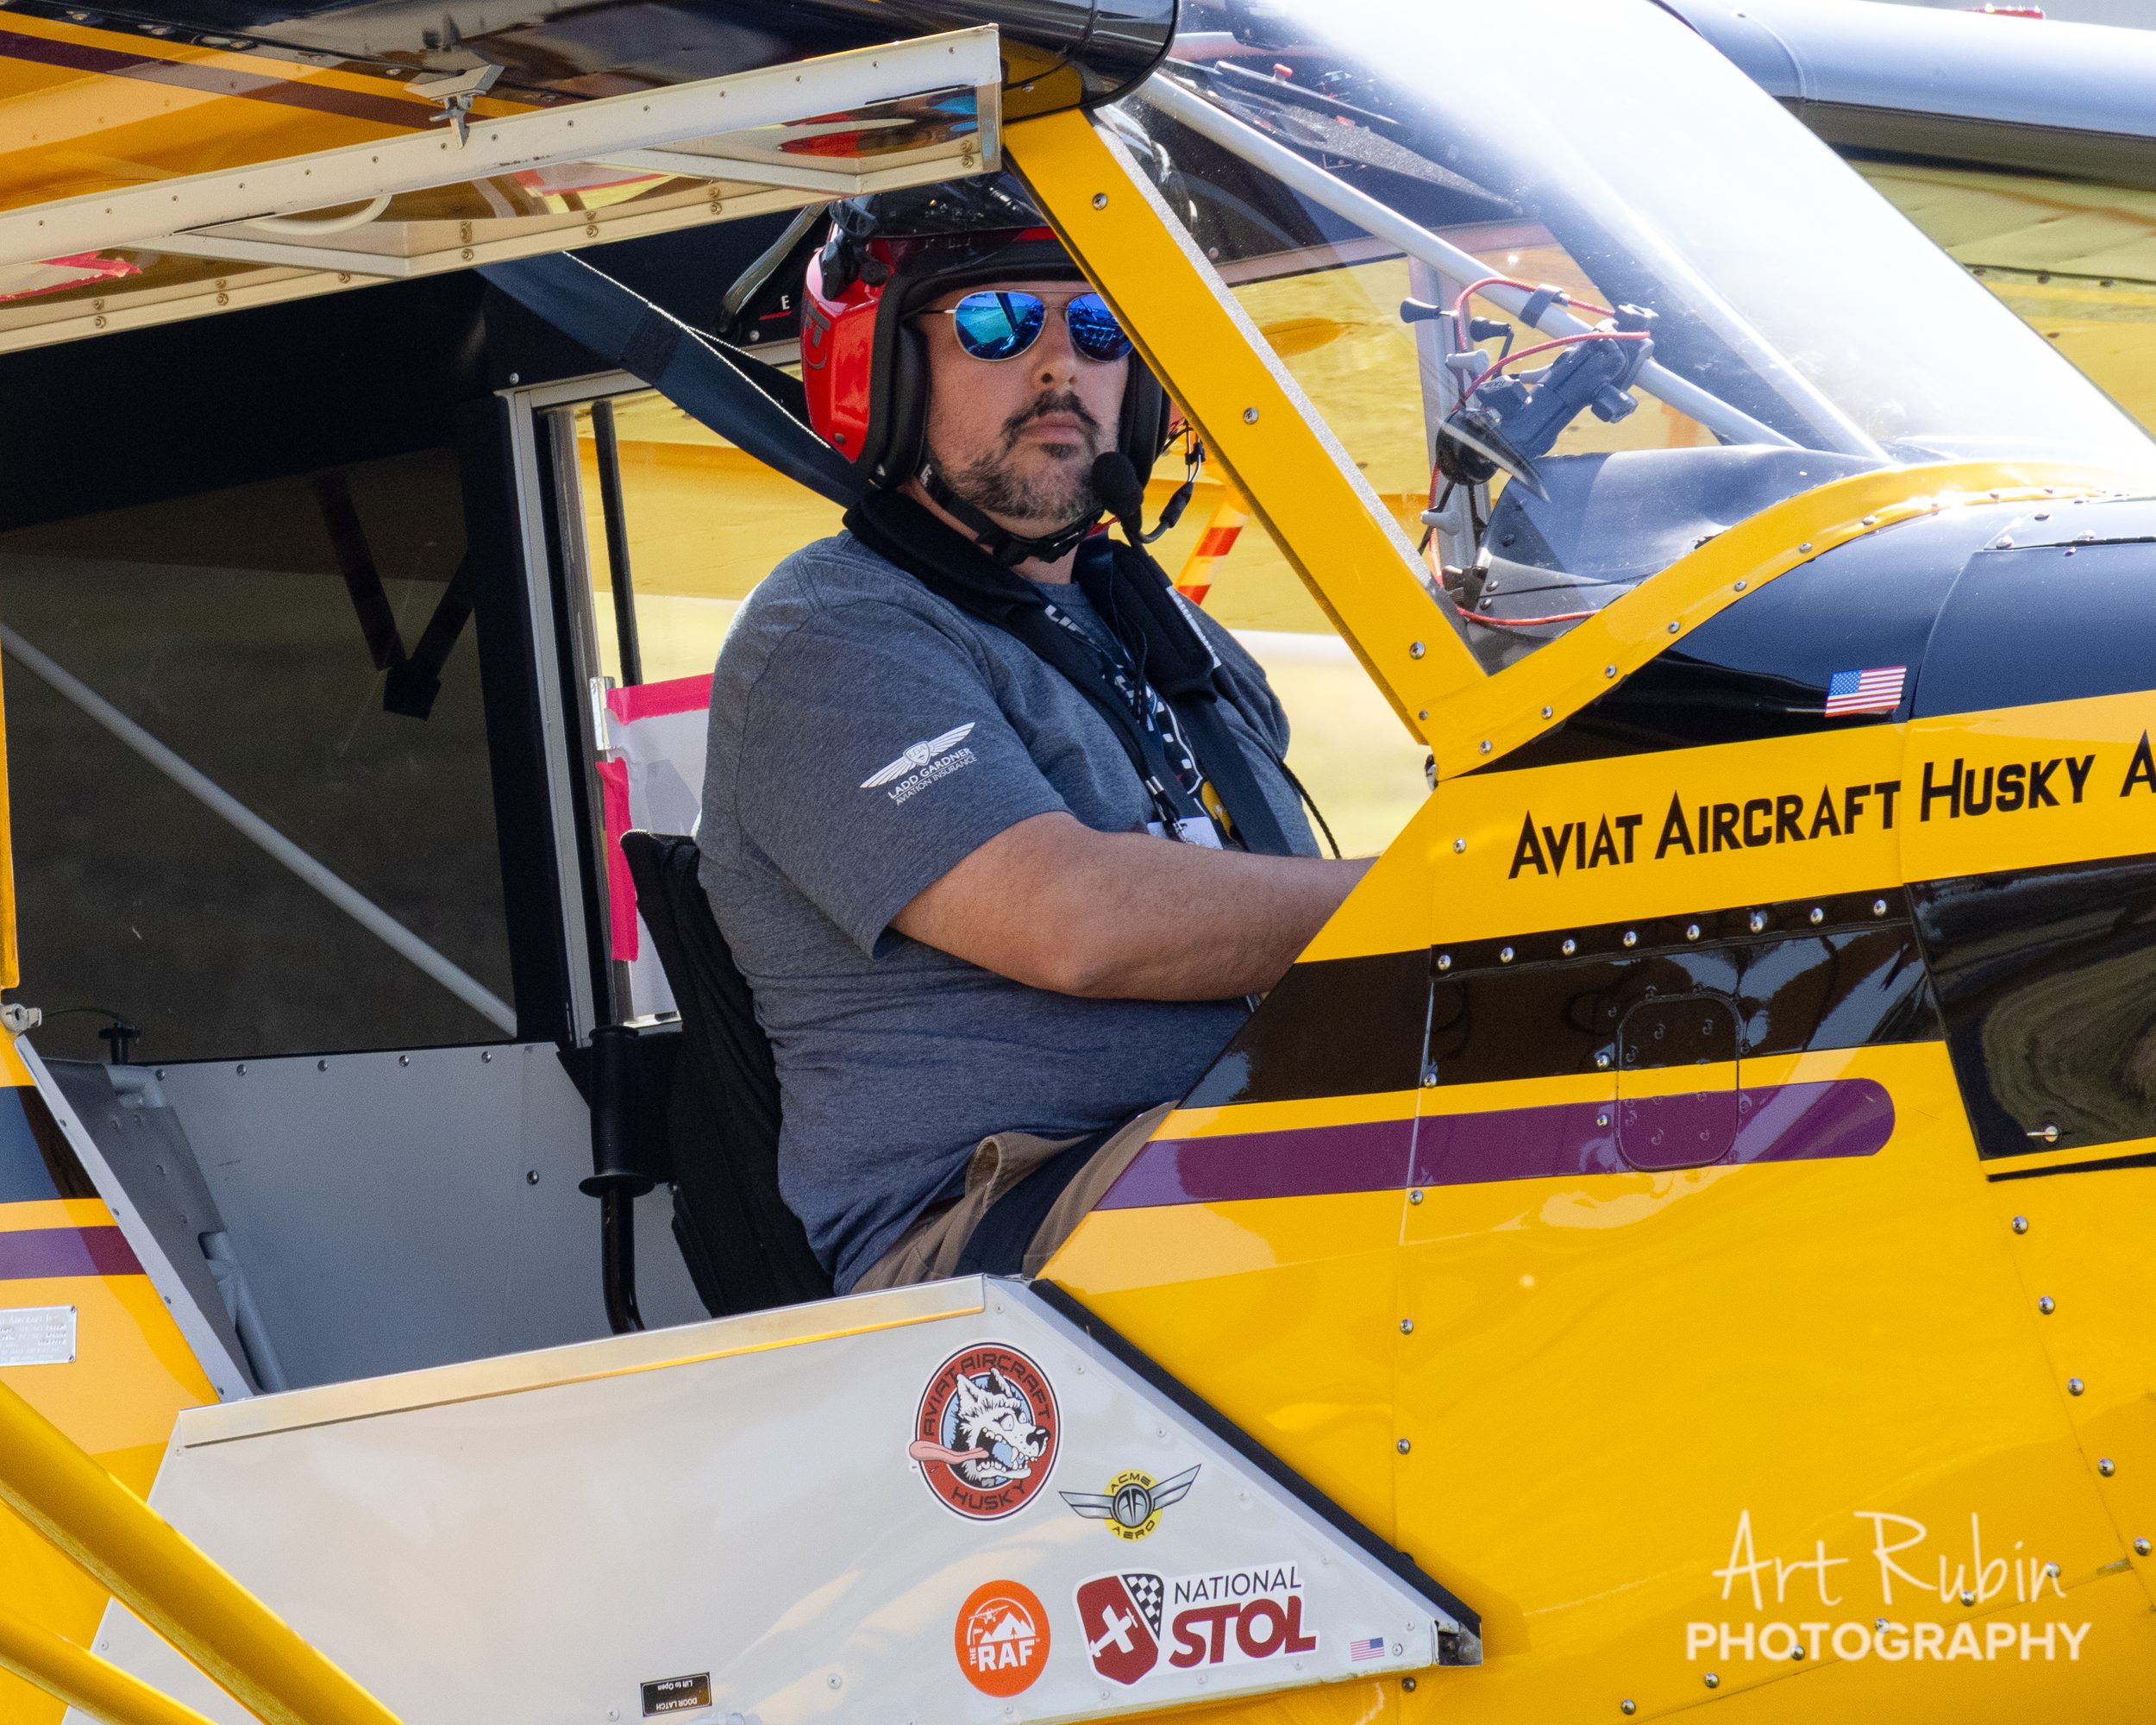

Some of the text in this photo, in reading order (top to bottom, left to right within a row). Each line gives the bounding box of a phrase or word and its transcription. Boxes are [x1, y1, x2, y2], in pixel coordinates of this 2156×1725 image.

[887, 748, 973, 800] LADD GARDNER
[897, 756, 977, 806] AVIATION INSURANCE
[1507, 809, 1643, 880] AVIAT
[1654, 780, 1901, 860] AIRCRAFT
[1920, 754, 2096, 822] HUSKY
[924, 1352, 1050, 1436] AVIAT AIRCRAFT
[951, 1481, 1026, 1511] HUSKY
[1110, 1472, 1152, 1493] ACME
[1112, 1520, 1156, 1540] AERO
[1175, 1566, 1301, 1604] NATIONAL
[1169, 1595, 1317, 1669] STOL
[977, 1639, 1035, 1672] RAF
[657, 1683, 674, 1691] Open
[683, 1679, 693, 1688] Lift
[655, 1697, 698, 1710] DOOR LATCH
